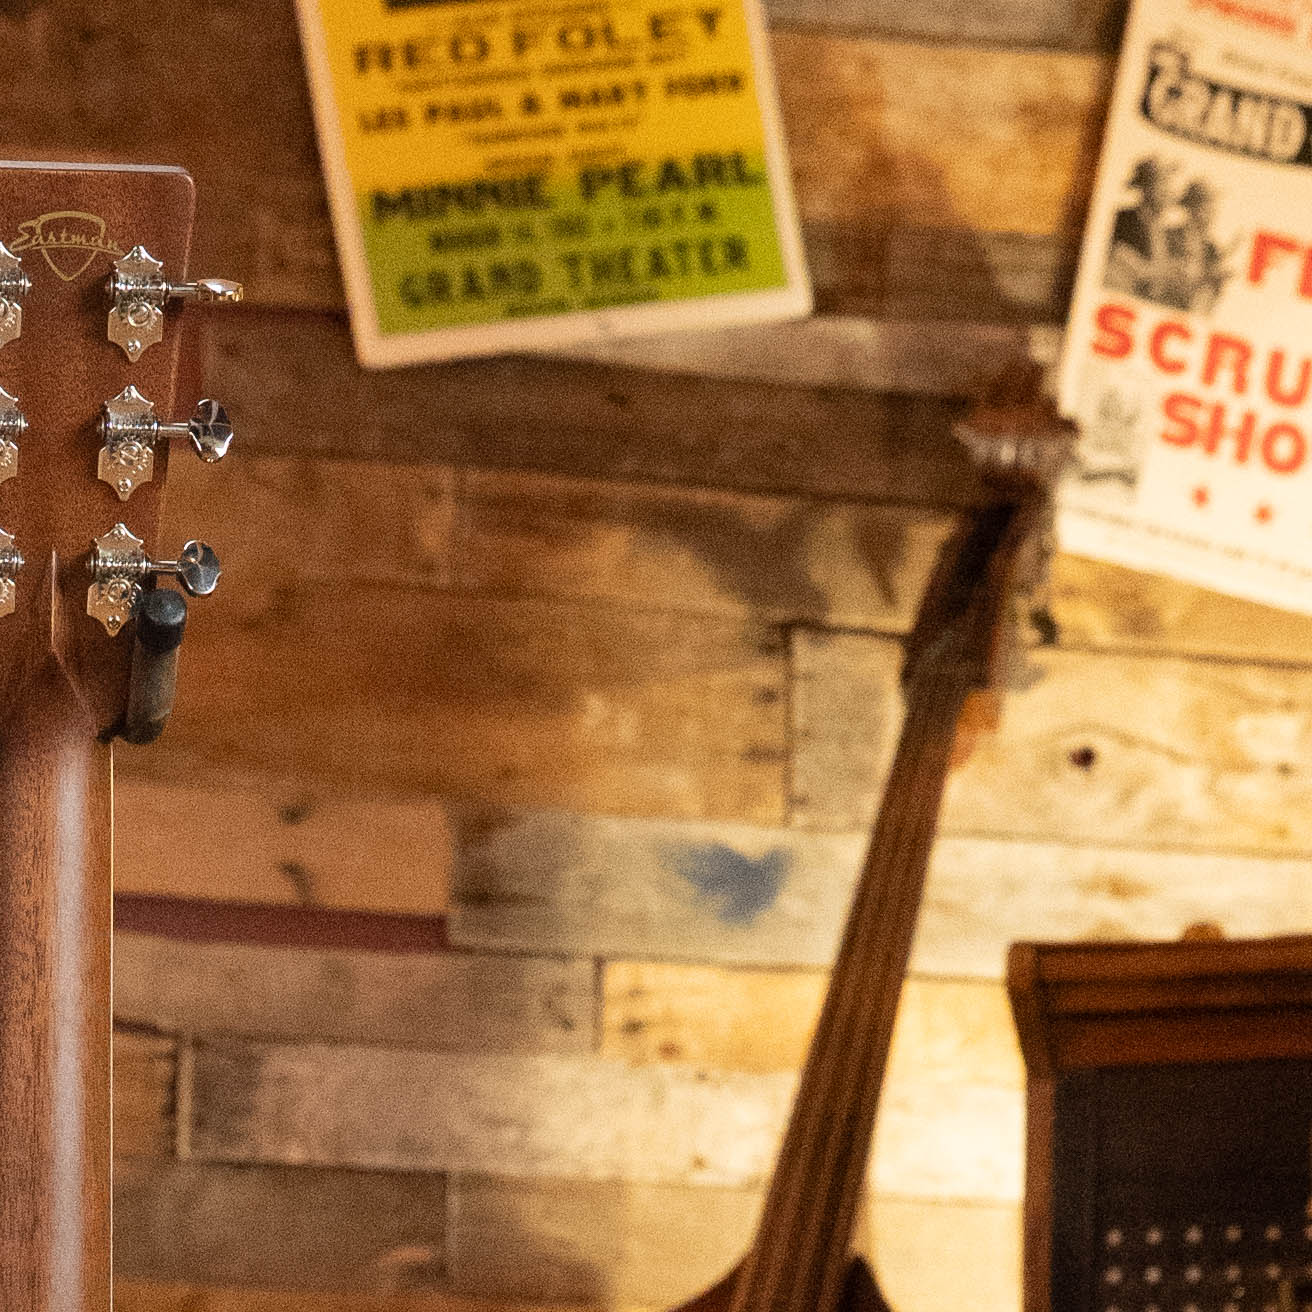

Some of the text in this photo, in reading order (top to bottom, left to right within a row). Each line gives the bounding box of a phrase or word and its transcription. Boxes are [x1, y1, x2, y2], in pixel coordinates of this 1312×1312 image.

[353, 34, 491, 76] RED
[512, 8, 723, 58] FOLEY
[1148, 55, 1306, 162] GRAND
[371, 174, 556, 224] MINNIE
[578, 150, 767, 201] PEARL
[10, 218, 125, 255] Eastman
[397, 257, 544, 310] GRAND
[560, 236, 750, 292] THEATER
[1159, 393, 1308, 476] SHO
